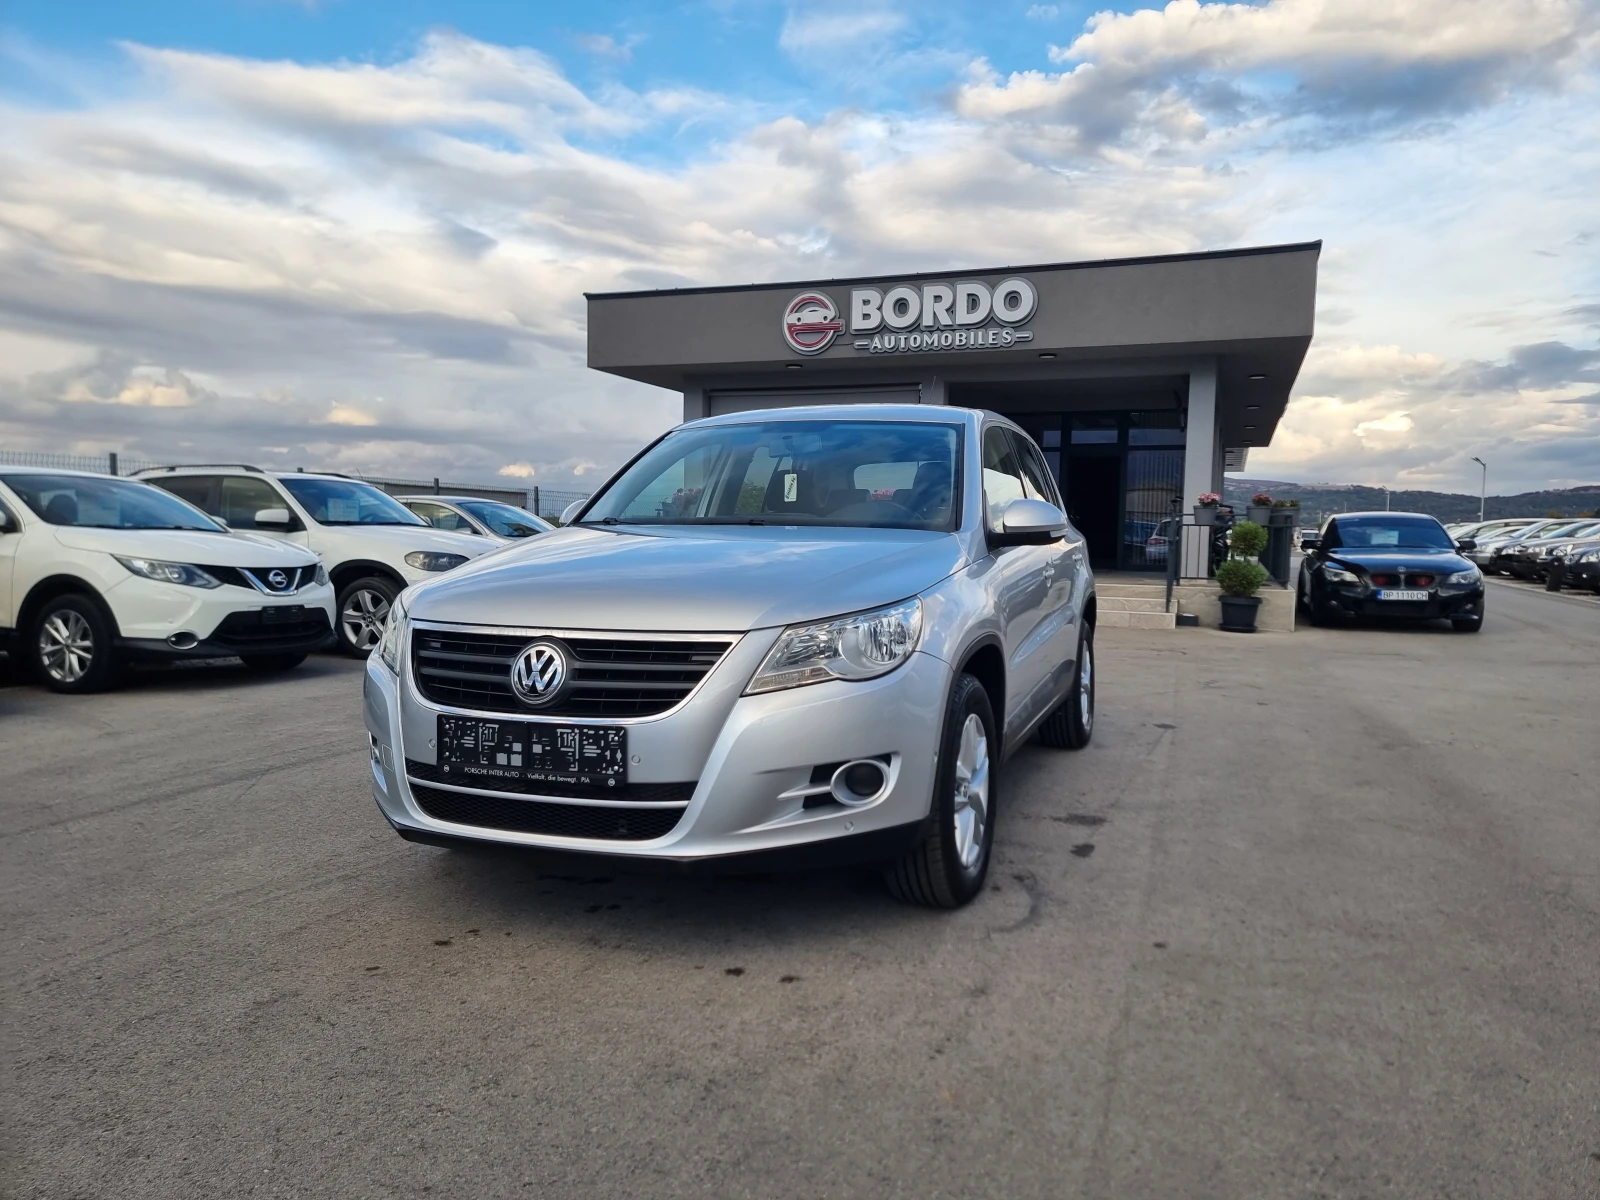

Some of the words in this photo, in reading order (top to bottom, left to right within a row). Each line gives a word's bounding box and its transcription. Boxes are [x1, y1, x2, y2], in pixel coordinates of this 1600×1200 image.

[851, 279, 1034, 330] BORDO
[871, 330, 1012, 350] AUTOMOBILES
[513, 644, 564, 701] VW
[464, 767, 488, 776] PORSCHE
[527, 773, 547, 781] Vielfalt,
